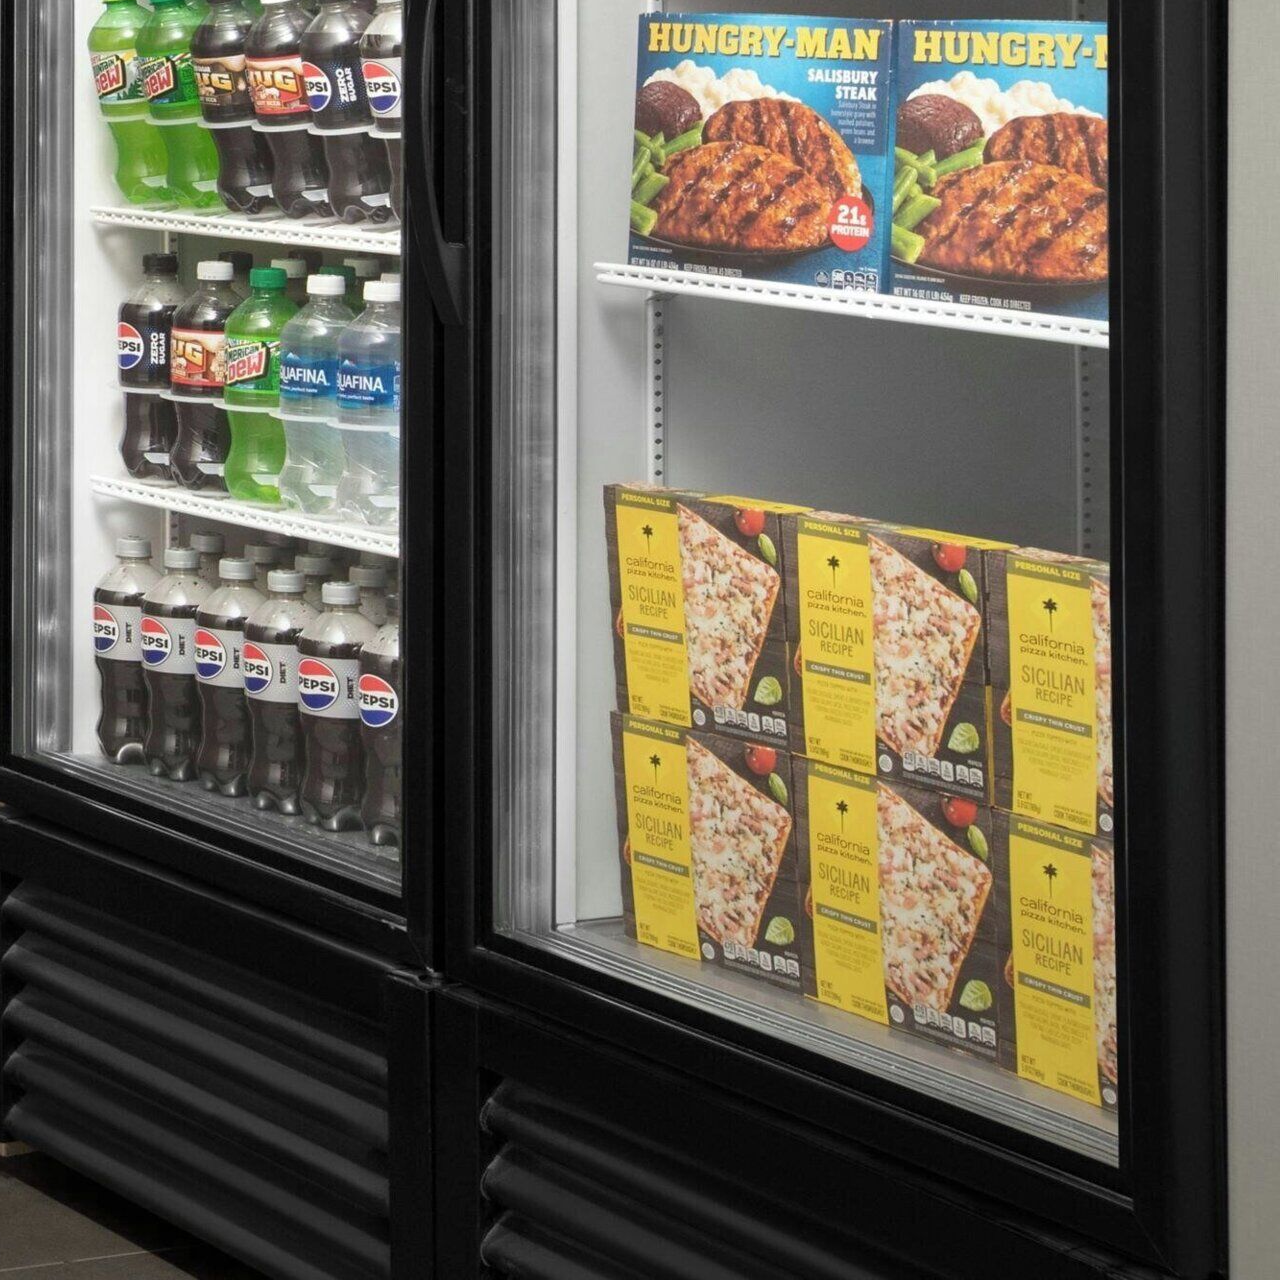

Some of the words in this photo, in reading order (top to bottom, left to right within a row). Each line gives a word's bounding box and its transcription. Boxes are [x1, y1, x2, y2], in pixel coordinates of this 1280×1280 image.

[647, 23, 884, 61] HUNGRY-MAN
[807, 68, 879, 85] SALISBURY
[835, 85, 878, 101] STEAK
[830, 224, 869, 239] PROTEIN
[150, 333, 158, 365] ZERO
[625, 556, 675, 573] california
[1015, 559, 1060, 576] PERSONAL
[1062, 570, 1081, 581] SIZE
[628, 584, 676, 608] SICILIAN
[807, 588, 864, 608] california
[808, 618, 865, 646] SICILIAN
[1019, 632, 1085, 655] california
[1020, 645, 1046, 657] pizza
[298, 676, 336, 693] PEPSI
[1021, 665, 1085, 695] SICILIAN
[1035, 687, 1073, 707] RECIPE
[1023, 712, 1048, 724] CRISPY
[1049, 718, 1063, 728] THIN
[1064, 721, 1086, 733] CRUST
